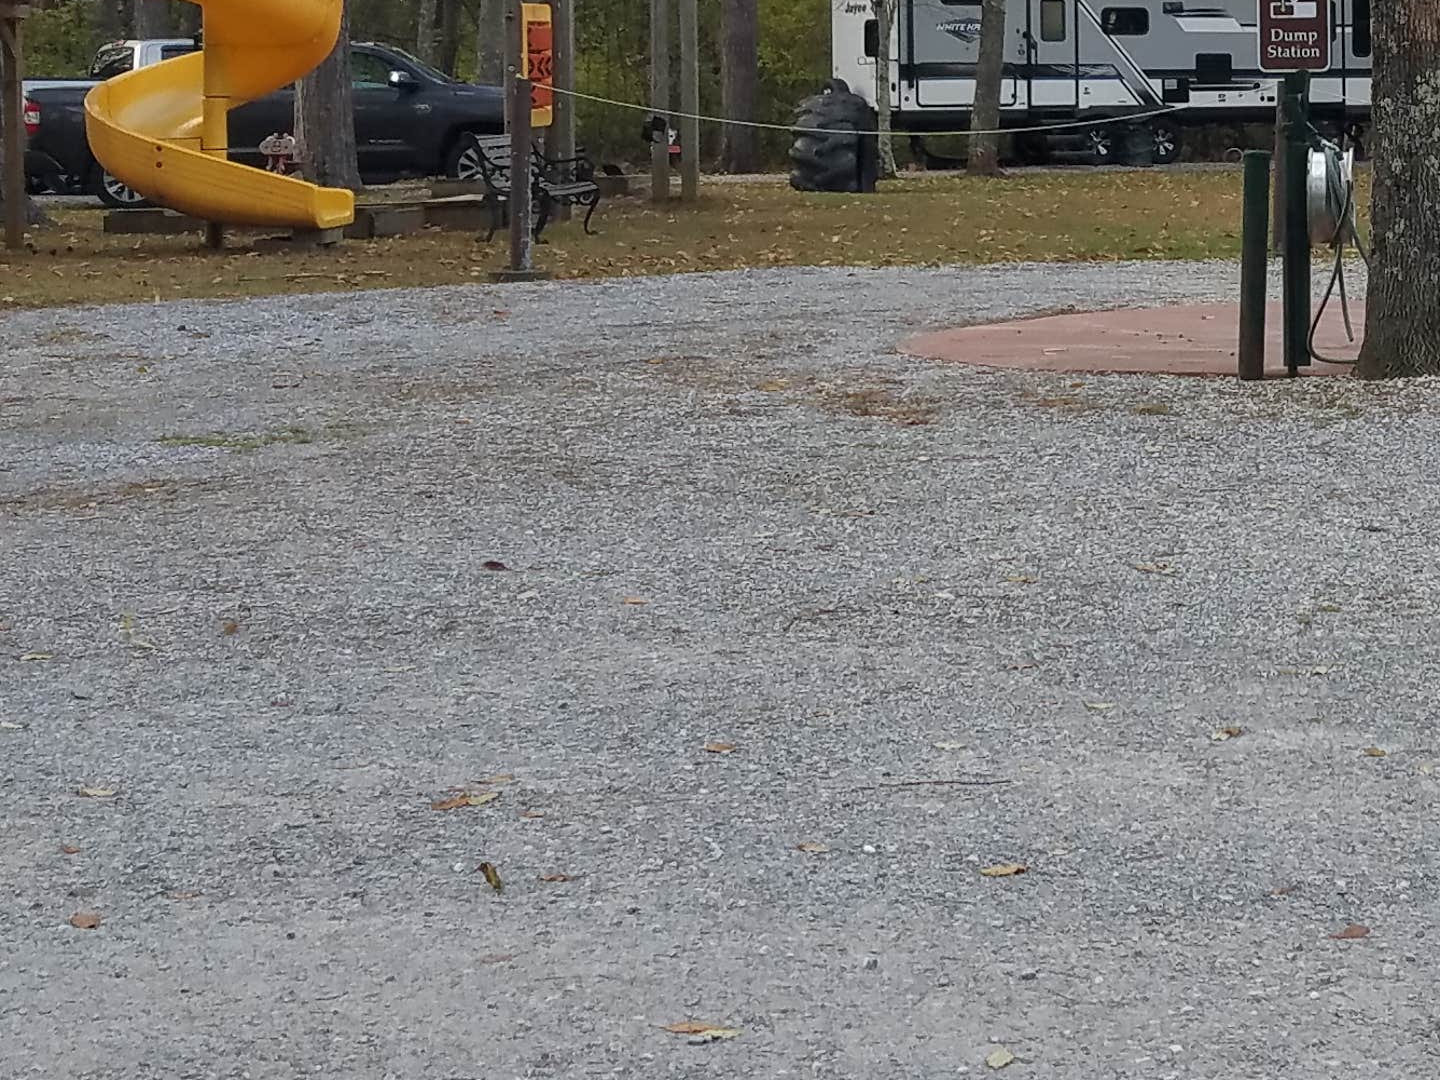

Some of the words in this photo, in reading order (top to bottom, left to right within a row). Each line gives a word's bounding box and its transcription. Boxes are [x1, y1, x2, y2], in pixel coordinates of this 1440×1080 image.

[936, 23, 967, 31] WHITE
[1270, 28, 1318, 45] Dump
[1267, 44, 1320, 58] Station
